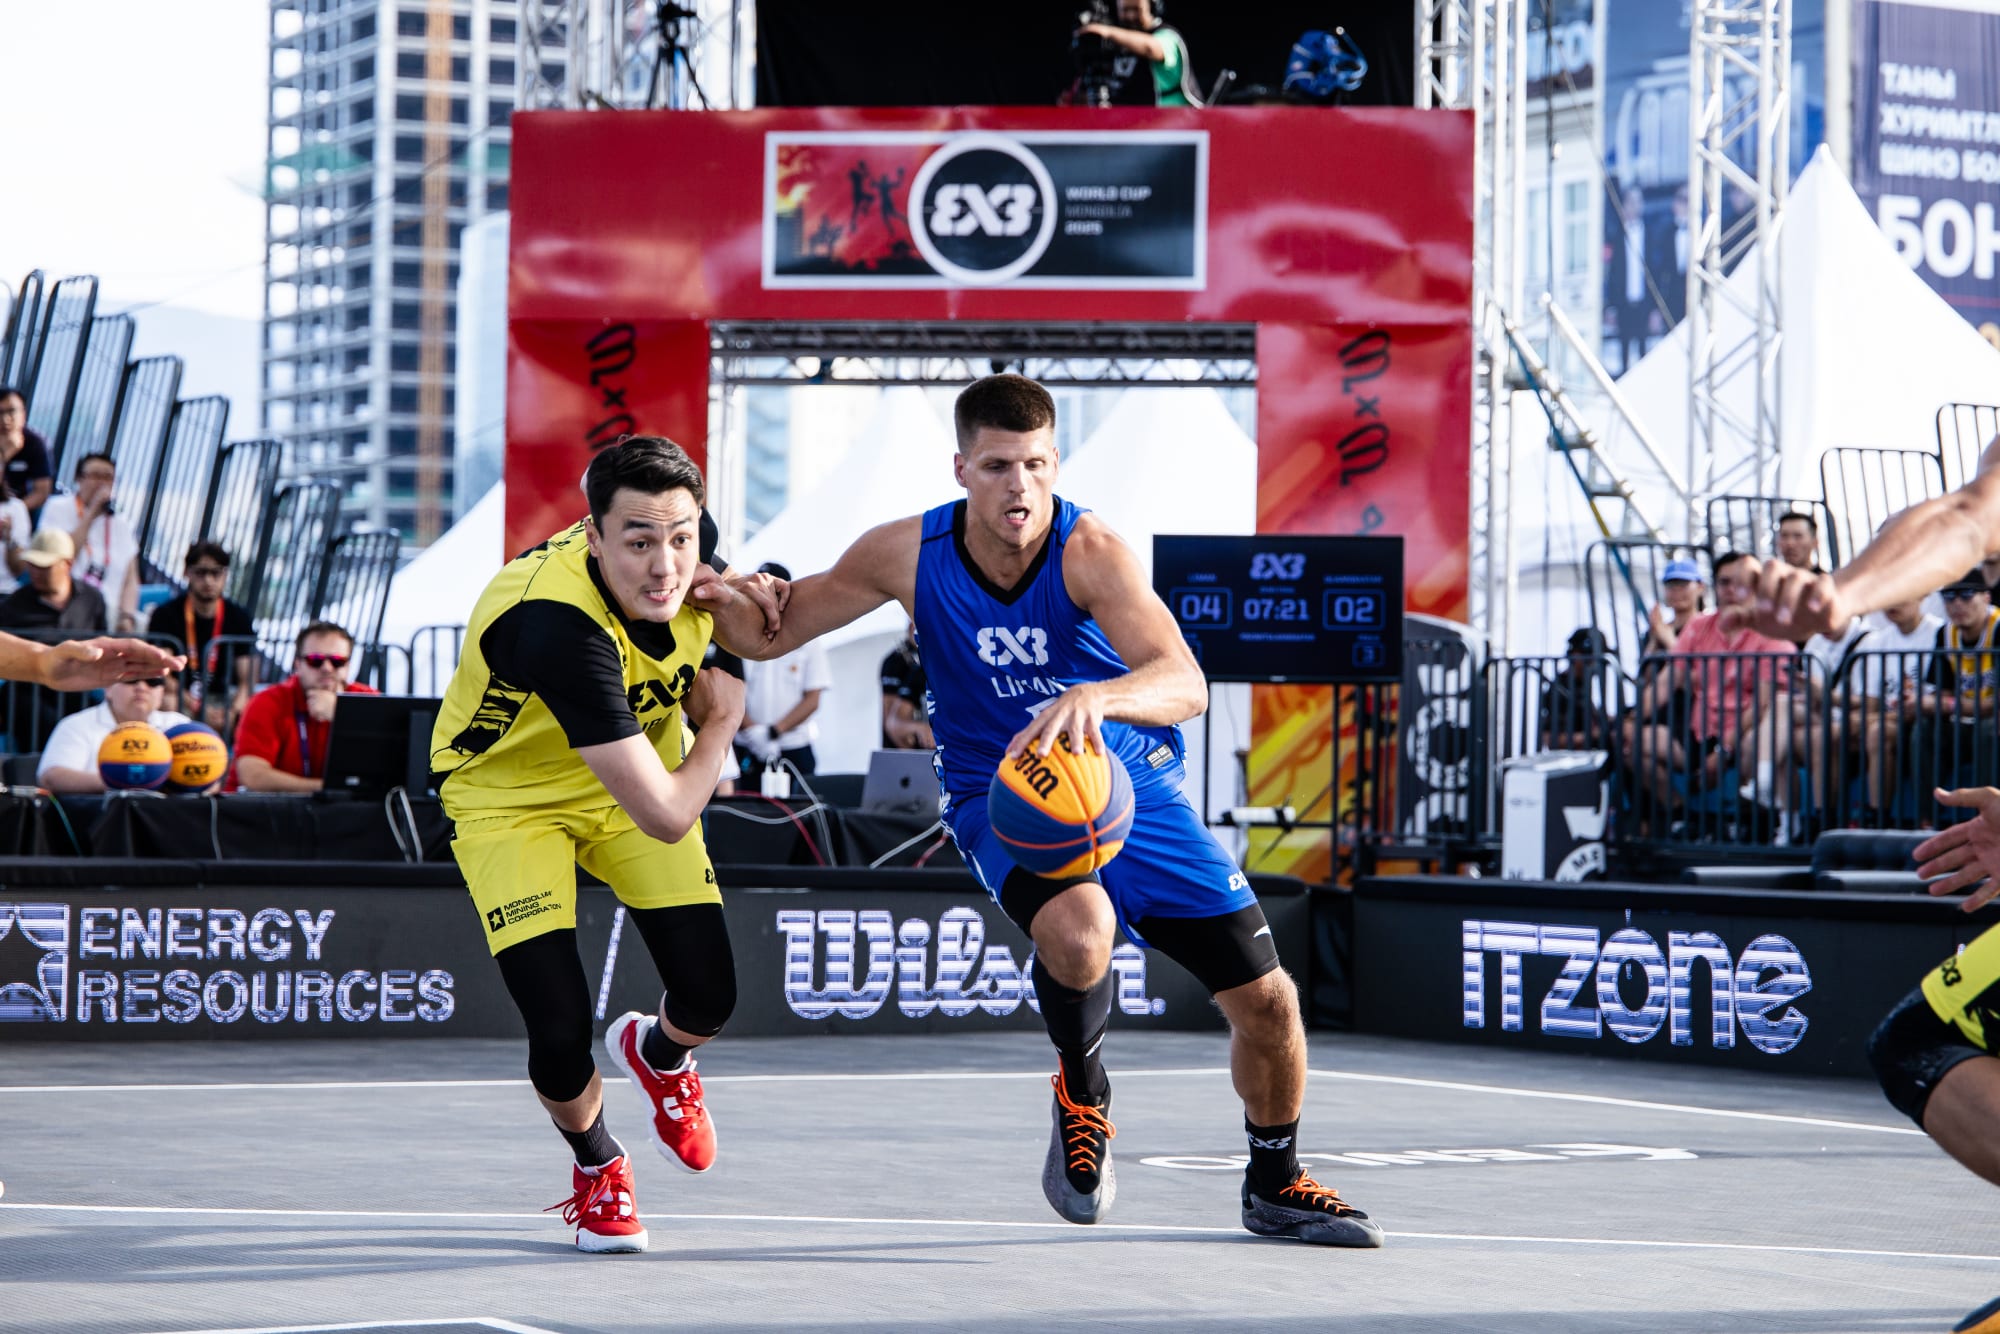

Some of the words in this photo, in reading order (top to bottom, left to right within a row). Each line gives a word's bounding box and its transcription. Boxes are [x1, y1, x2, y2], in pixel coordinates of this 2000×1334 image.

[1962, 149, 2000, 184] БО
[1065, 186, 1119, 201] WORLD
[1120, 186, 1152, 201] CUP
[1064, 221, 1103, 235] 2025
[1181, 595, 1221, 621] 04
[1243, 599, 1309, 621] 07:21
[1334, 597, 1375, 623] 02
[505, 901, 540, 918] MINING
[80, 907, 335, 961] ENERGY
[77, 969, 455, 1023] RESOURCES
